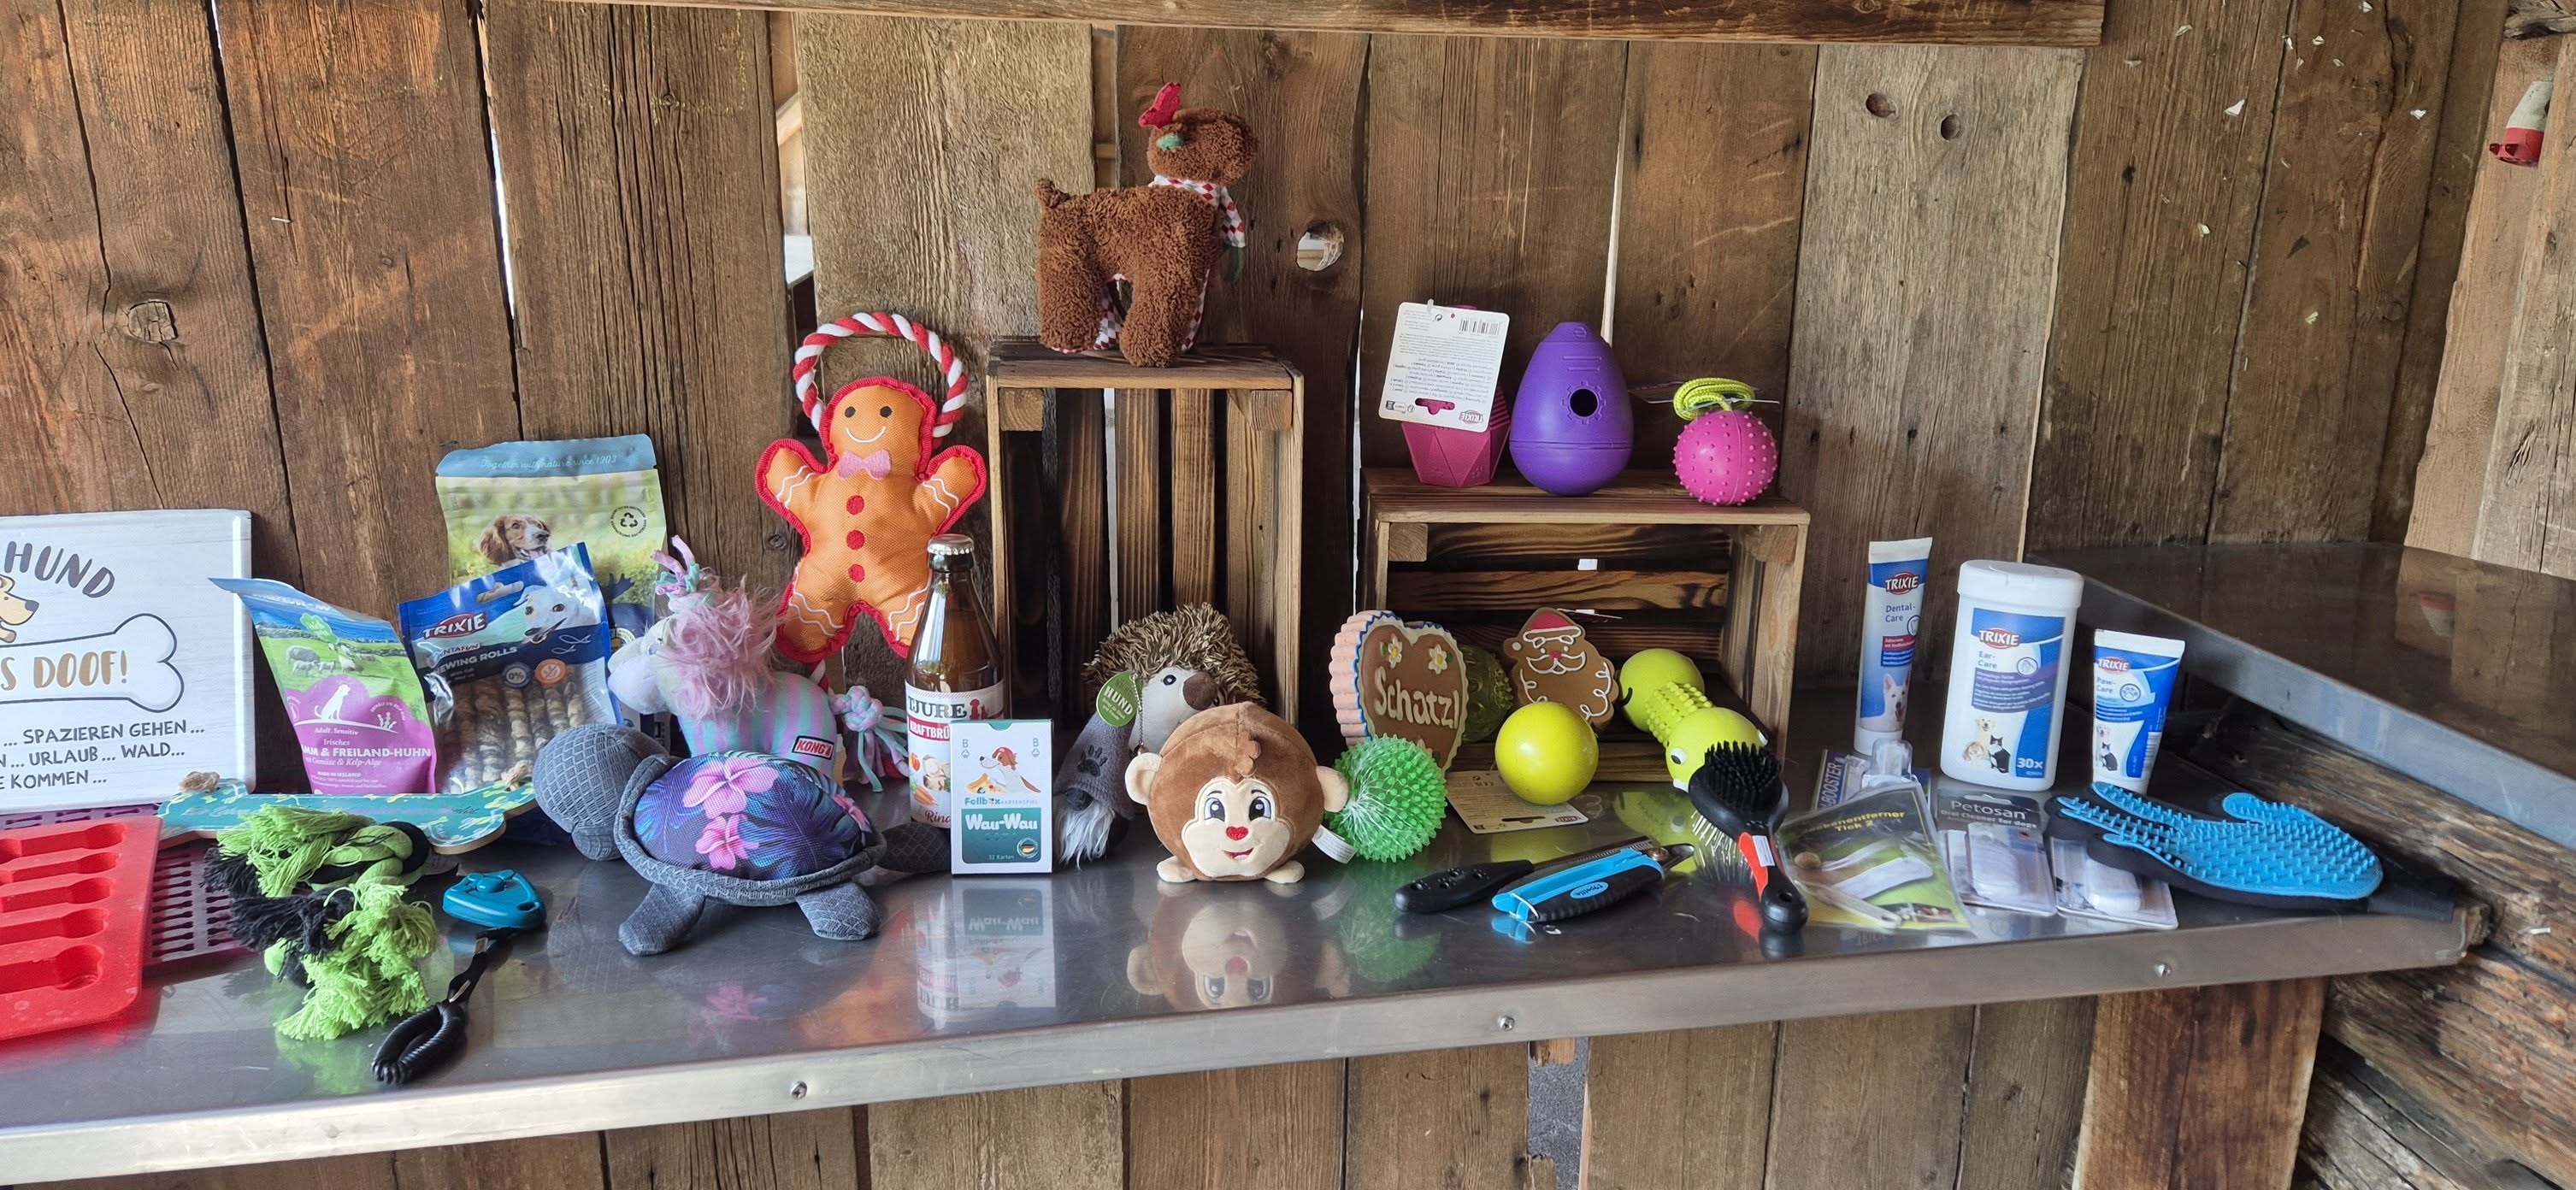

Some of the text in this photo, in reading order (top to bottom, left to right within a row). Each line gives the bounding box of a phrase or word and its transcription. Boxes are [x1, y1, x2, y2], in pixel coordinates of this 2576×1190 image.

[1459, 411, 1484, 425] TRIXIE
[595, 454, 617, 464] 1903
[3, 540, 115, 598] HUND
[1885, 575, 1919, 591] TRIXIE
[1885, 603, 1916, 613] Dental-
[422, 612, 486, 639] TRIXIE
[1979, 630, 2019, 645] TRIXIE
[480, 646, 517, 661] ROLLS
[33, 650, 127, 689] DOOF!
[1978, 660, 1997, 669] Care
[2097, 658, 2130, 671] TRIXIE
[2096, 685, 2113, 693] Care
[1104, 686, 1133, 715] HUND
[23, 724, 124, 745] SPAZIEREN
[129, 720, 187, 737] GEHEN
[796, 740, 826, 754] KONG
[963, 739, 969, 748] B
[1033, 738, 1039, 747] B
[29, 746, 98, 766] URLAUB
[301, 745, 432, 757] AMM & FREILAND-HUHN
[346, 757, 382, 768] Kelp-Alge
[2017, 757, 2043, 769] 30x
[11, 770, 89, 789] KOMMEN
[1819, 762, 1842, 808] -BOOSTER
[1950, 800, 2026, 821] Petosan
[964, 813, 1038, 830] Wau-Wau
[1805, 811, 1906, 834] eckenentferner
[1835, 822, 1863, 832] Tick
